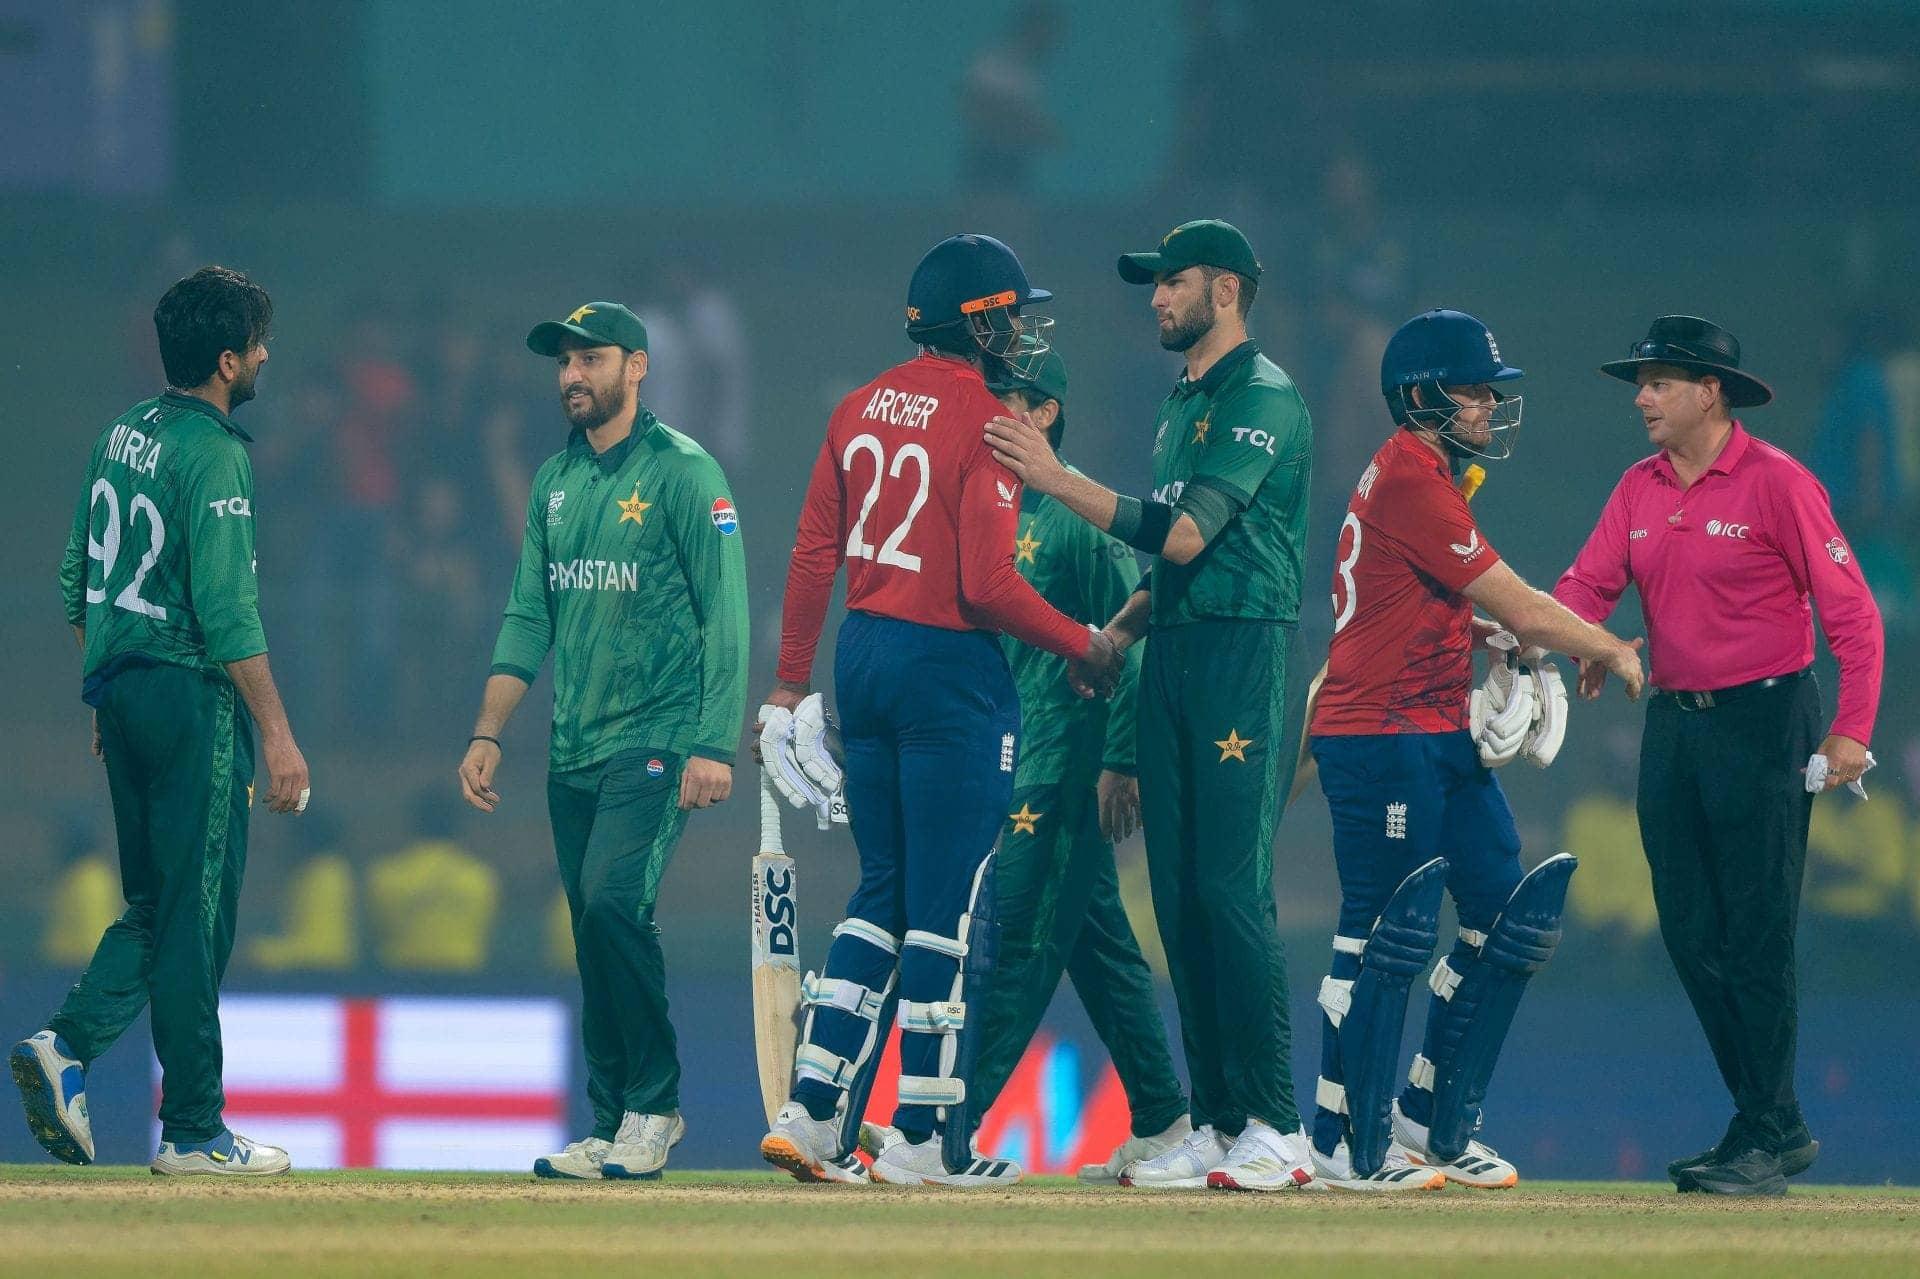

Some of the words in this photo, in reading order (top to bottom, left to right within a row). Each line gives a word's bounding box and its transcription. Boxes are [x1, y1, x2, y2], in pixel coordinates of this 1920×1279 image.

[861, 388, 939, 431] ARCHER
[105, 424, 162, 480] MIRZA
[1231, 427, 1276, 456] TCL
[209, 496, 252, 518] TCL
[842, 433, 930, 574] 22
[86, 477, 167, 621] 92
[1721, 523, 1750, 539] ICC
[548, 558, 638, 592] PAKISTAN
[831, 802, 849, 815] SC
[752, 872, 761, 924] FEARLESS
[764, 865, 796, 956] DSC
